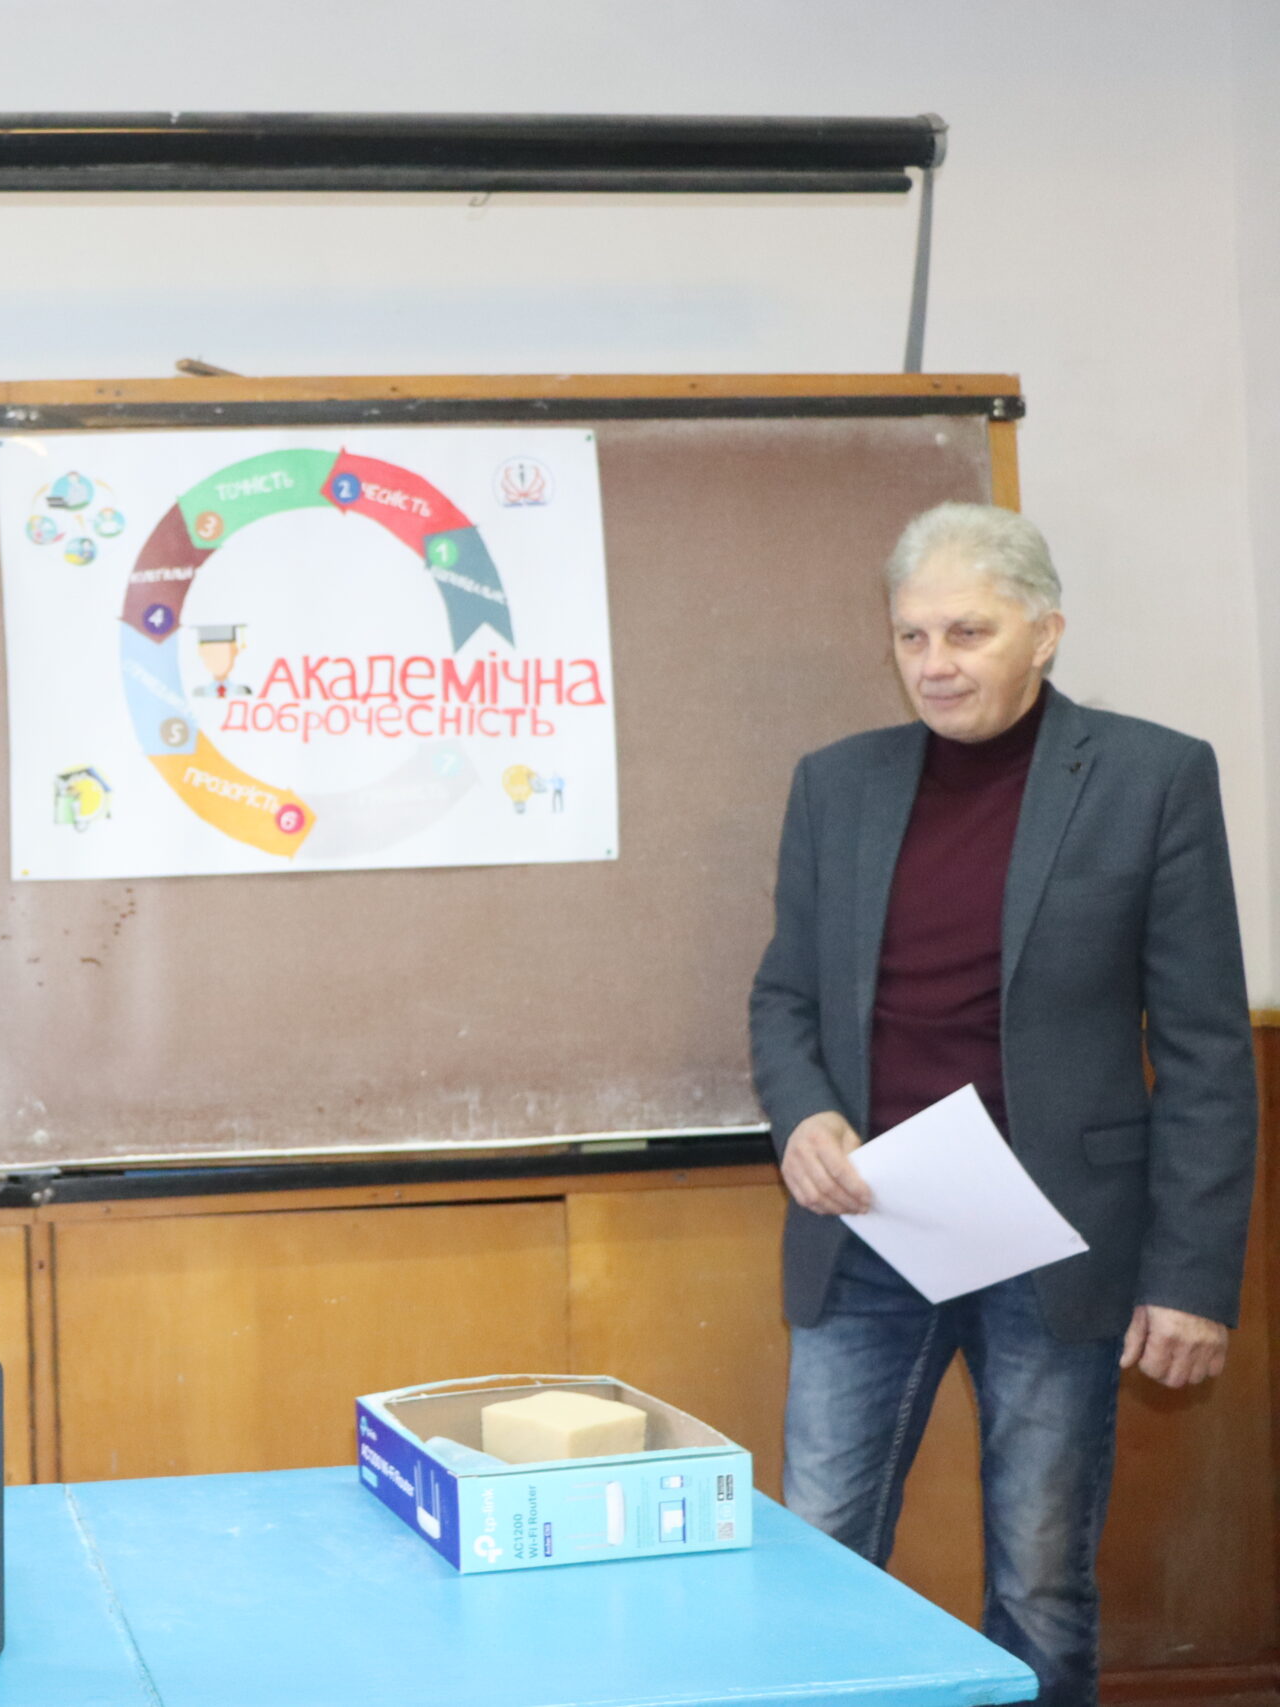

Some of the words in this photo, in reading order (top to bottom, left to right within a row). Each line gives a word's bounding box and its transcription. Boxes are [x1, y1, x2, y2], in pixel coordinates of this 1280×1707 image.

[337, 480, 353, 499] 2
[197, 516, 217, 538] 3
[435, 542, 449, 563] 1
[148, 607, 165, 629] 4
[279, 810, 297, 831] 6
[527, 1484, 537, 1525] Router
[513, 1513, 524, 1559] AC1200
[527, 1527, 538, 1559] Wi-Fi
